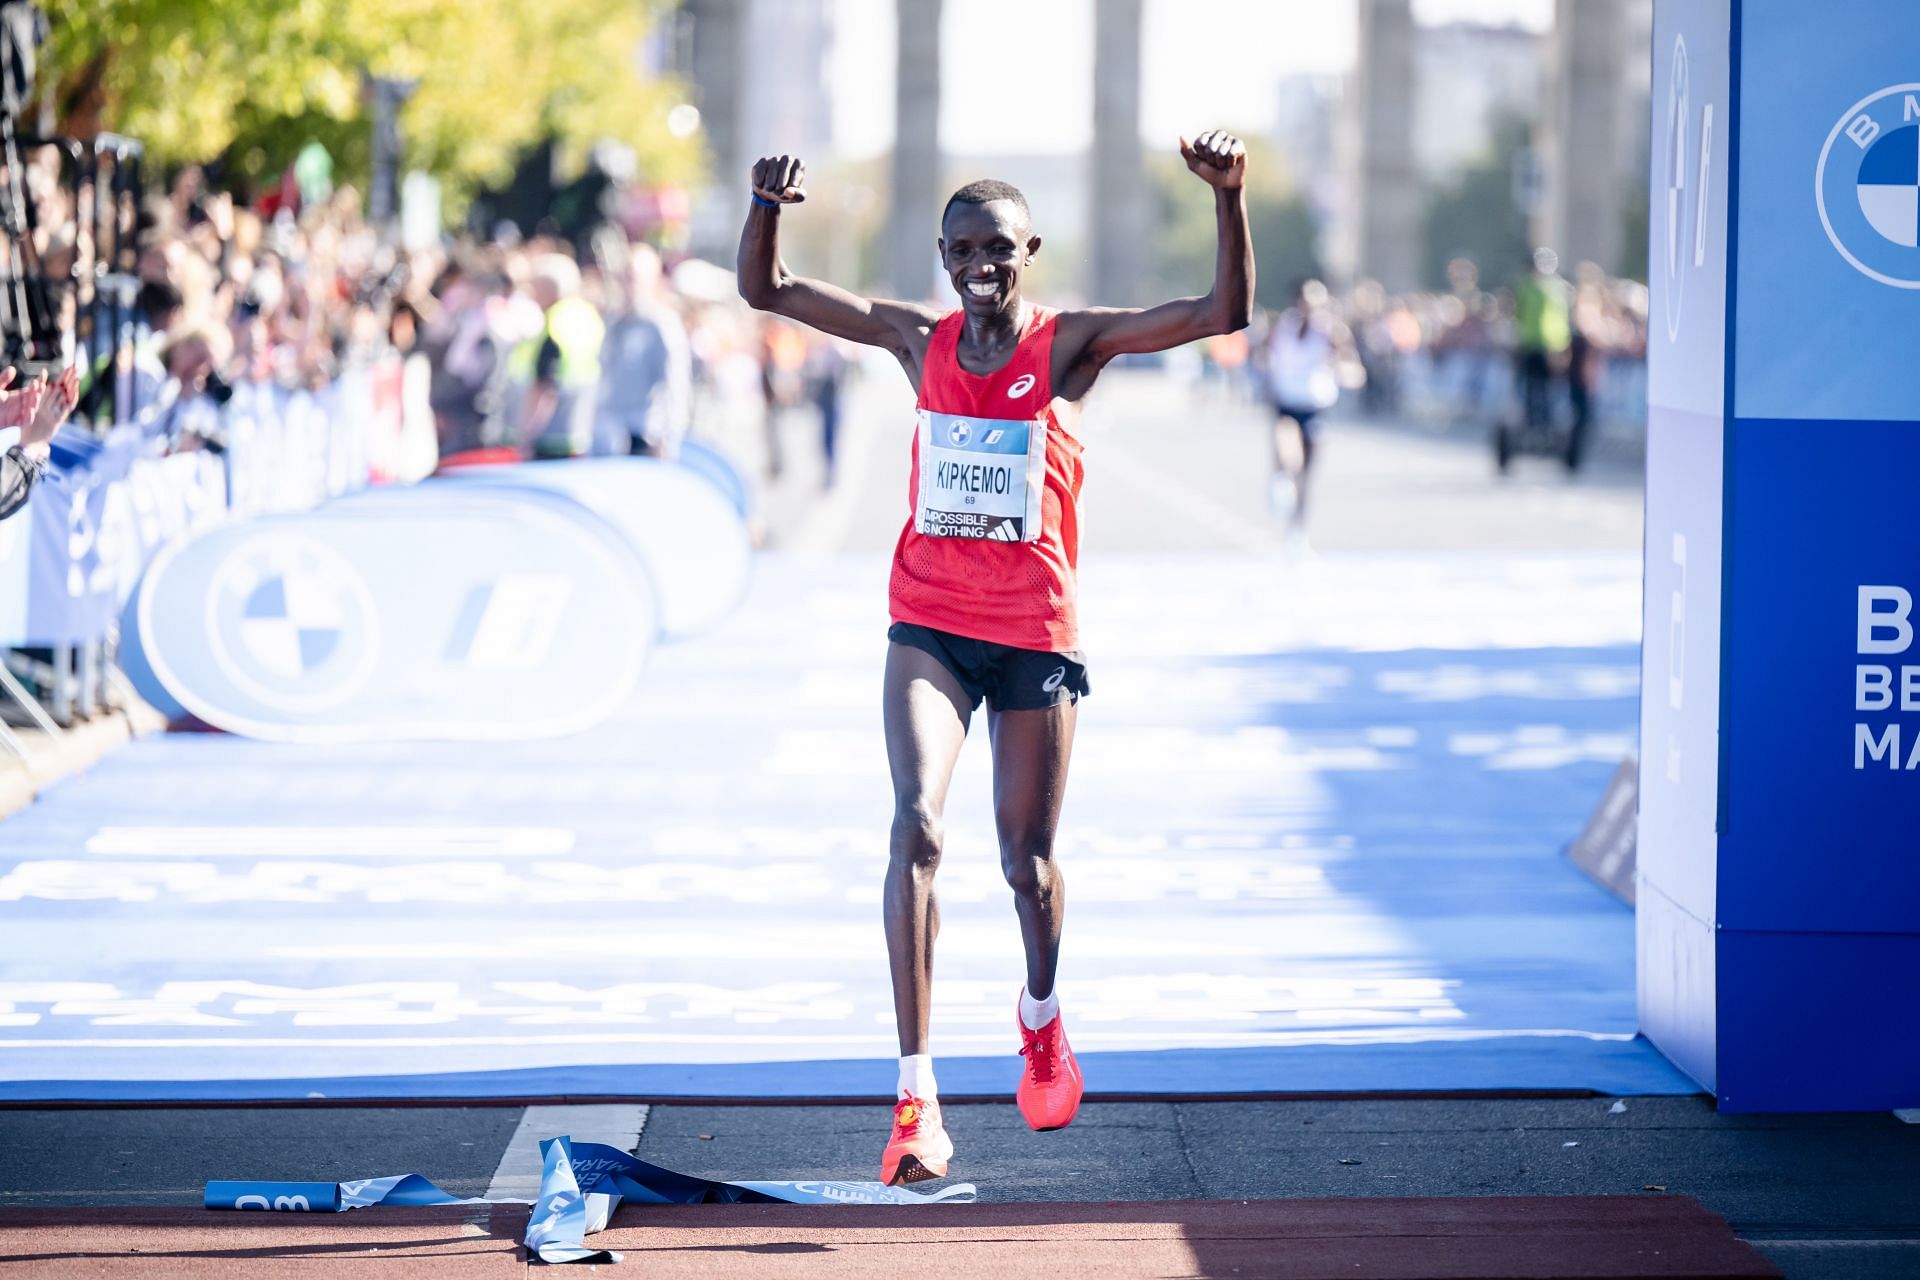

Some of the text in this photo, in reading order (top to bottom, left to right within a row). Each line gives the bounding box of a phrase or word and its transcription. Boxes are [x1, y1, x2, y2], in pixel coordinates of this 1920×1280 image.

[1844, 94, 1920, 150] BM
[937, 461, 1011, 494] KIPKEMOI
[965, 496, 975, 504] 69
[926, 509, 988, 526] MPOSSIBLE
[931, 523, 985, 538] NOTHING
[1857, 585, 1914, 654] B
[1856, 664, 1920, 711] BE
[571, 1159, 631, 1172] MARA
